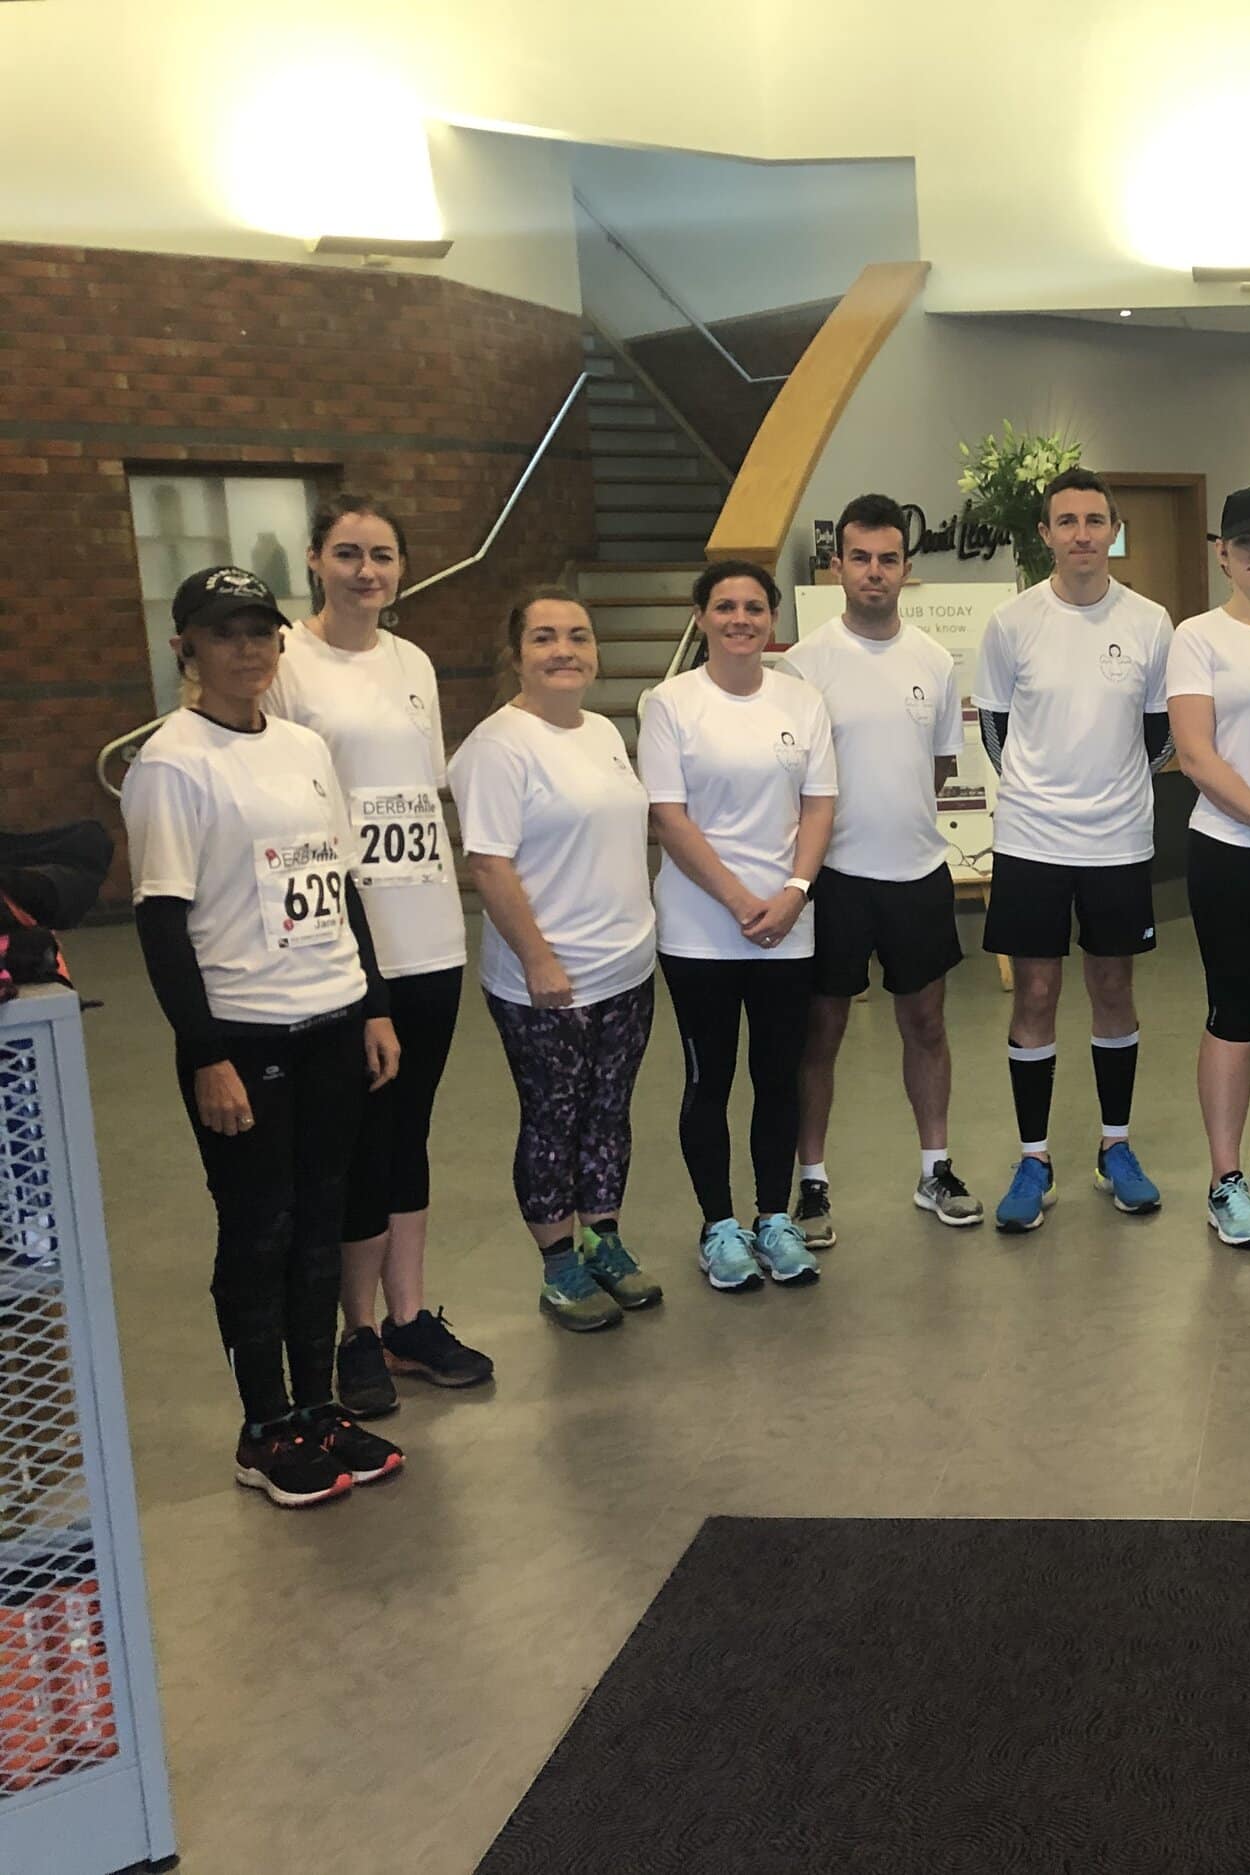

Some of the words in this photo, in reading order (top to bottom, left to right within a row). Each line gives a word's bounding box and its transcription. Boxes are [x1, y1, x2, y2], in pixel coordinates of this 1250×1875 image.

[900, 504, 956, 557] David
[899, 607, 923, 618] LUB
[928, 605, 973, 617] TODAY
[361, 822, 440, 864] 2032
[284, 871, 341, 921] 629
